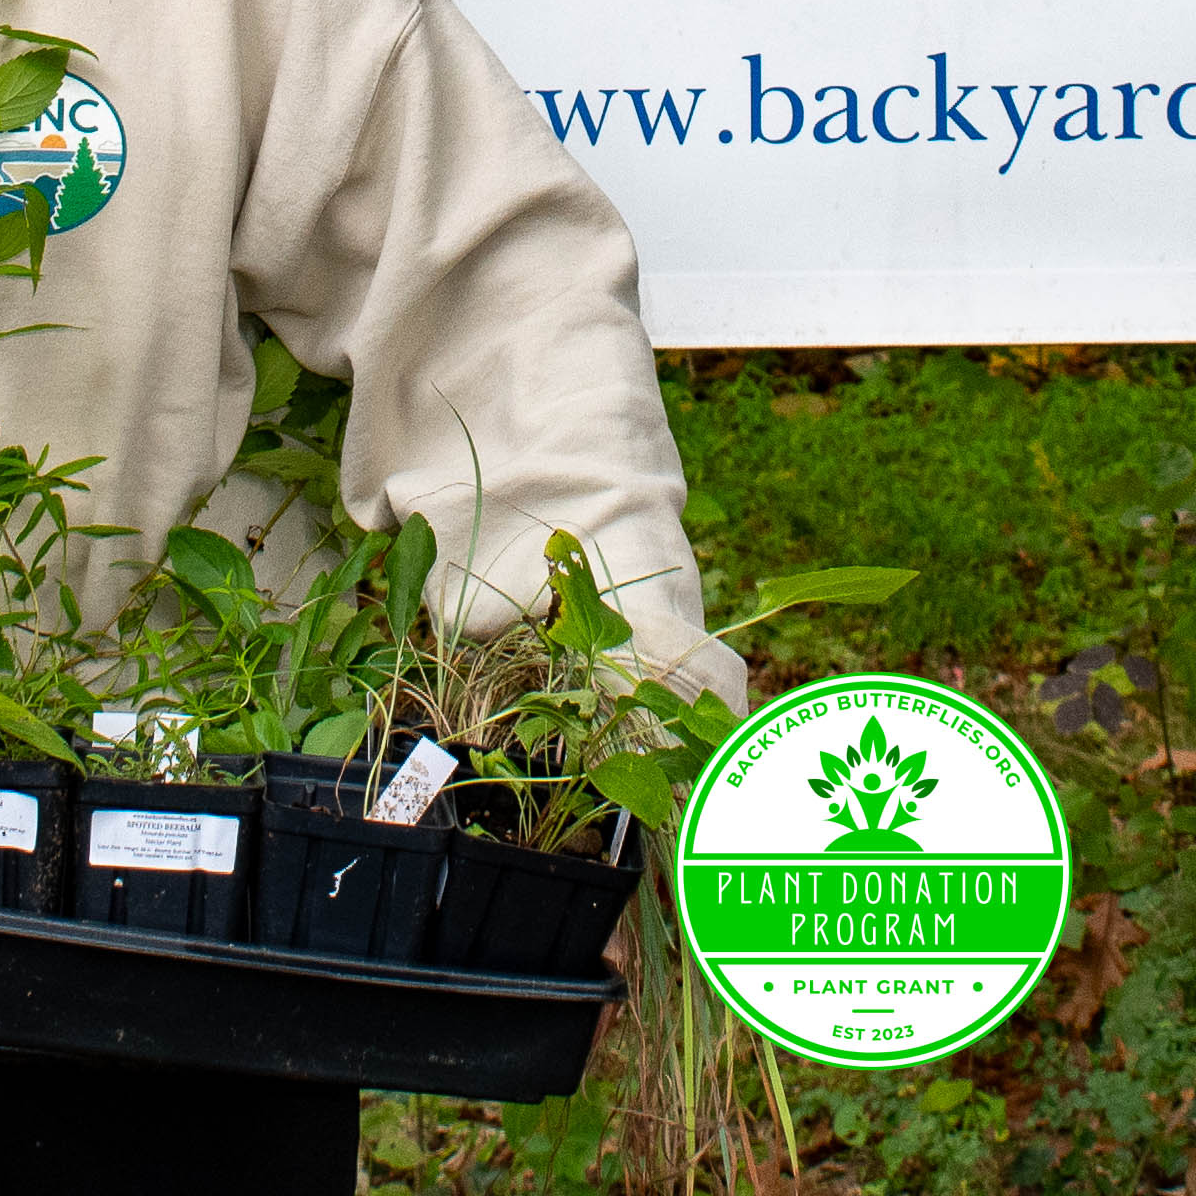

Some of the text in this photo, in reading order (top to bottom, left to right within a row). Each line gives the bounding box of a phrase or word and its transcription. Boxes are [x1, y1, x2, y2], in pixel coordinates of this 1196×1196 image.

[524, 51, 1196, 176] ww.backyar
[126, 820, 202, 832] SPOTTED BEEBALM
